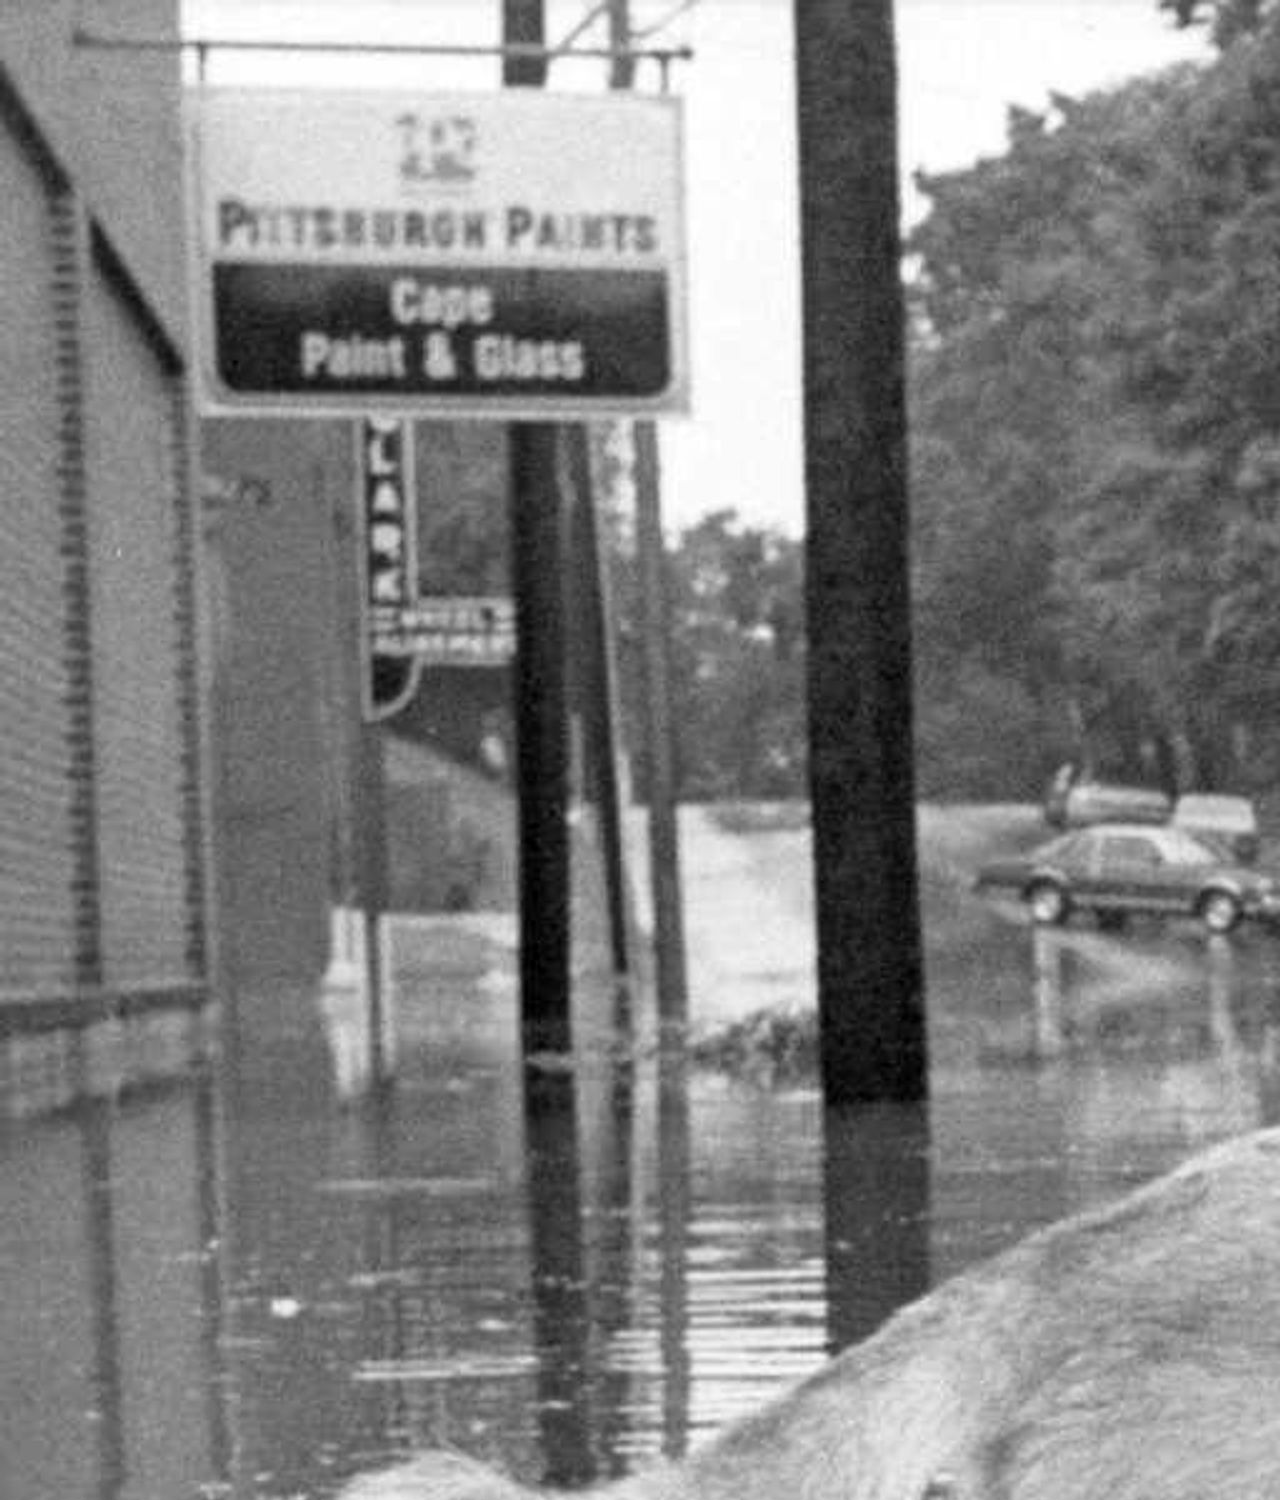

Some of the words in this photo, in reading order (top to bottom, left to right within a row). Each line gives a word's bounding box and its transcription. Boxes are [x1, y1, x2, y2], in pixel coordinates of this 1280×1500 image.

[218, 199, 485, 248] PITTSBURGH
[505, 207, 657, 252] PAINTS
[391, 278, 492, 329] Cape
[301, 332, 405, 379] Paint
[424, 332, 455, 379] &
[474, 335, 583, 379] Glass
